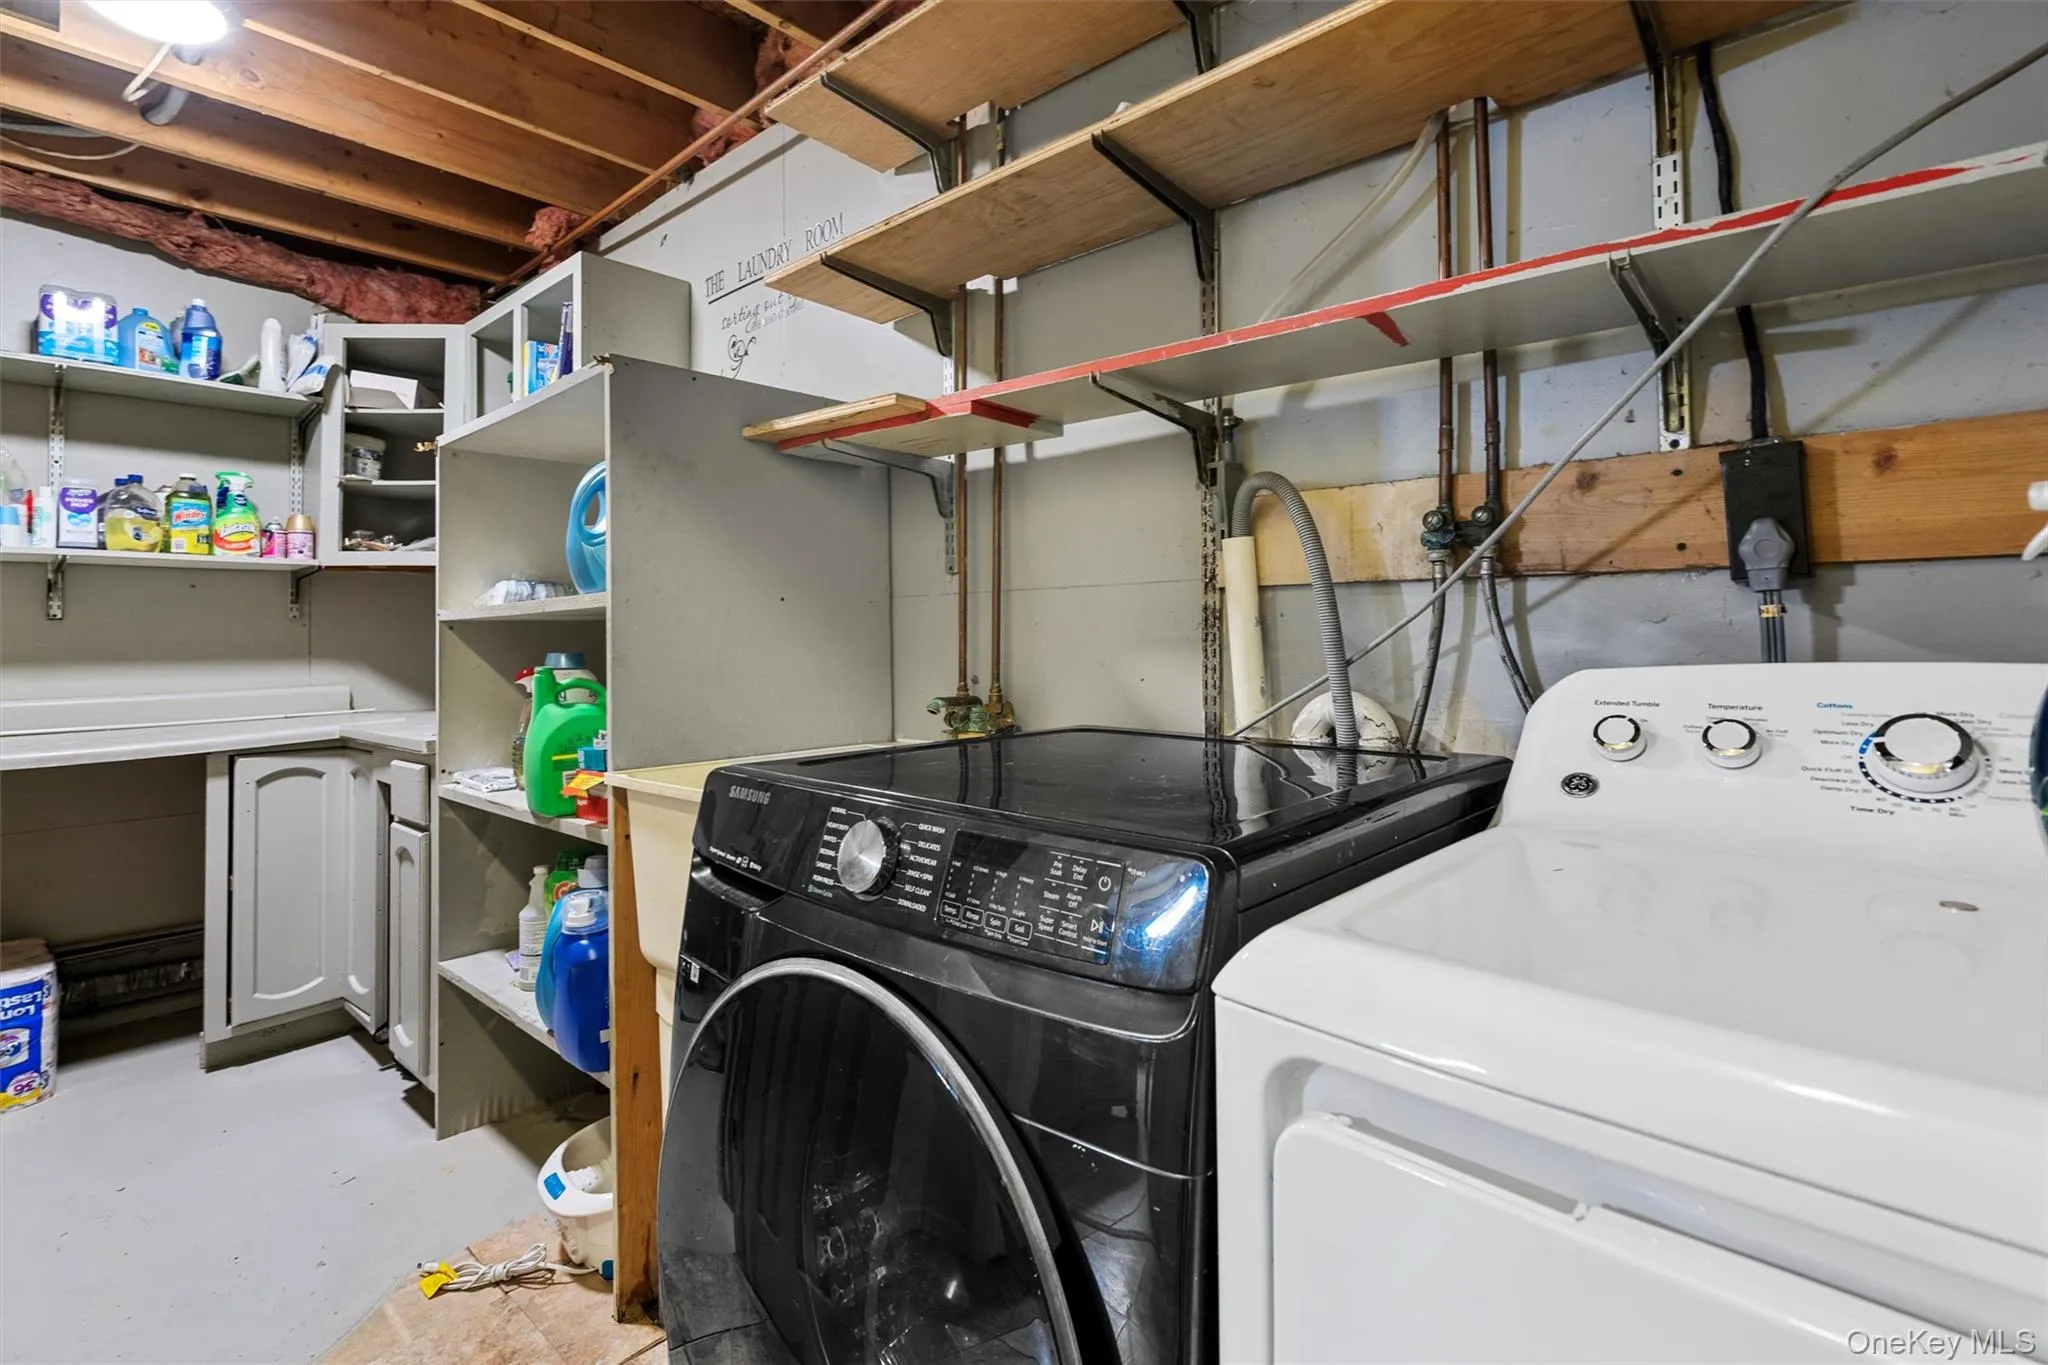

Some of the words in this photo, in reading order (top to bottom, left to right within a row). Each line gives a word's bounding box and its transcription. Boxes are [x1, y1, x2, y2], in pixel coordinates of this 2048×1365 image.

[704, 270, 725, 297] THE
[737, 239, 793, 282] LAUNDRY
[805, 212, 845, 252] ROOM
[1594, 699, 1630, 707] Extended
[1708, 703, 1763, 711] Temperature
[729, 786, 771, 805] SAMSUNG
[918, 823, 931, 831] QUICK
[932, 826, 946, 834] WASH
[917, 841, 941, 852] DELICATES
[909, 854, 938, 866] ACTIVEWEAR
[1053, 860, 1062, 868] Pre
[1050, 868, 1062, 876] Soak
[1072, 864, 1088, 874] Delay
[1073, 873, 1084, 881] End
[904, 884, 915, 892] SELF
[1043, 890, 1060, 900] Steam
[1066, 892, 1083, 901] Alarm
[966, 911, 979, 920] Rinse
[1040, 915, 1054, 924] Super
[990, 918, 1001, 926] Spin
[1038, 922, 1054, 932] Speed
[1061, 920, 1078, 930] Smart
[1015, 924, 1025, 933] Soil
[1058, 928, 1078, 939] Control
[0, 991, 43, 1009] Last
[0, 1004, 36, 1020] Lon
[14, 1080, 37, 1096] 36
